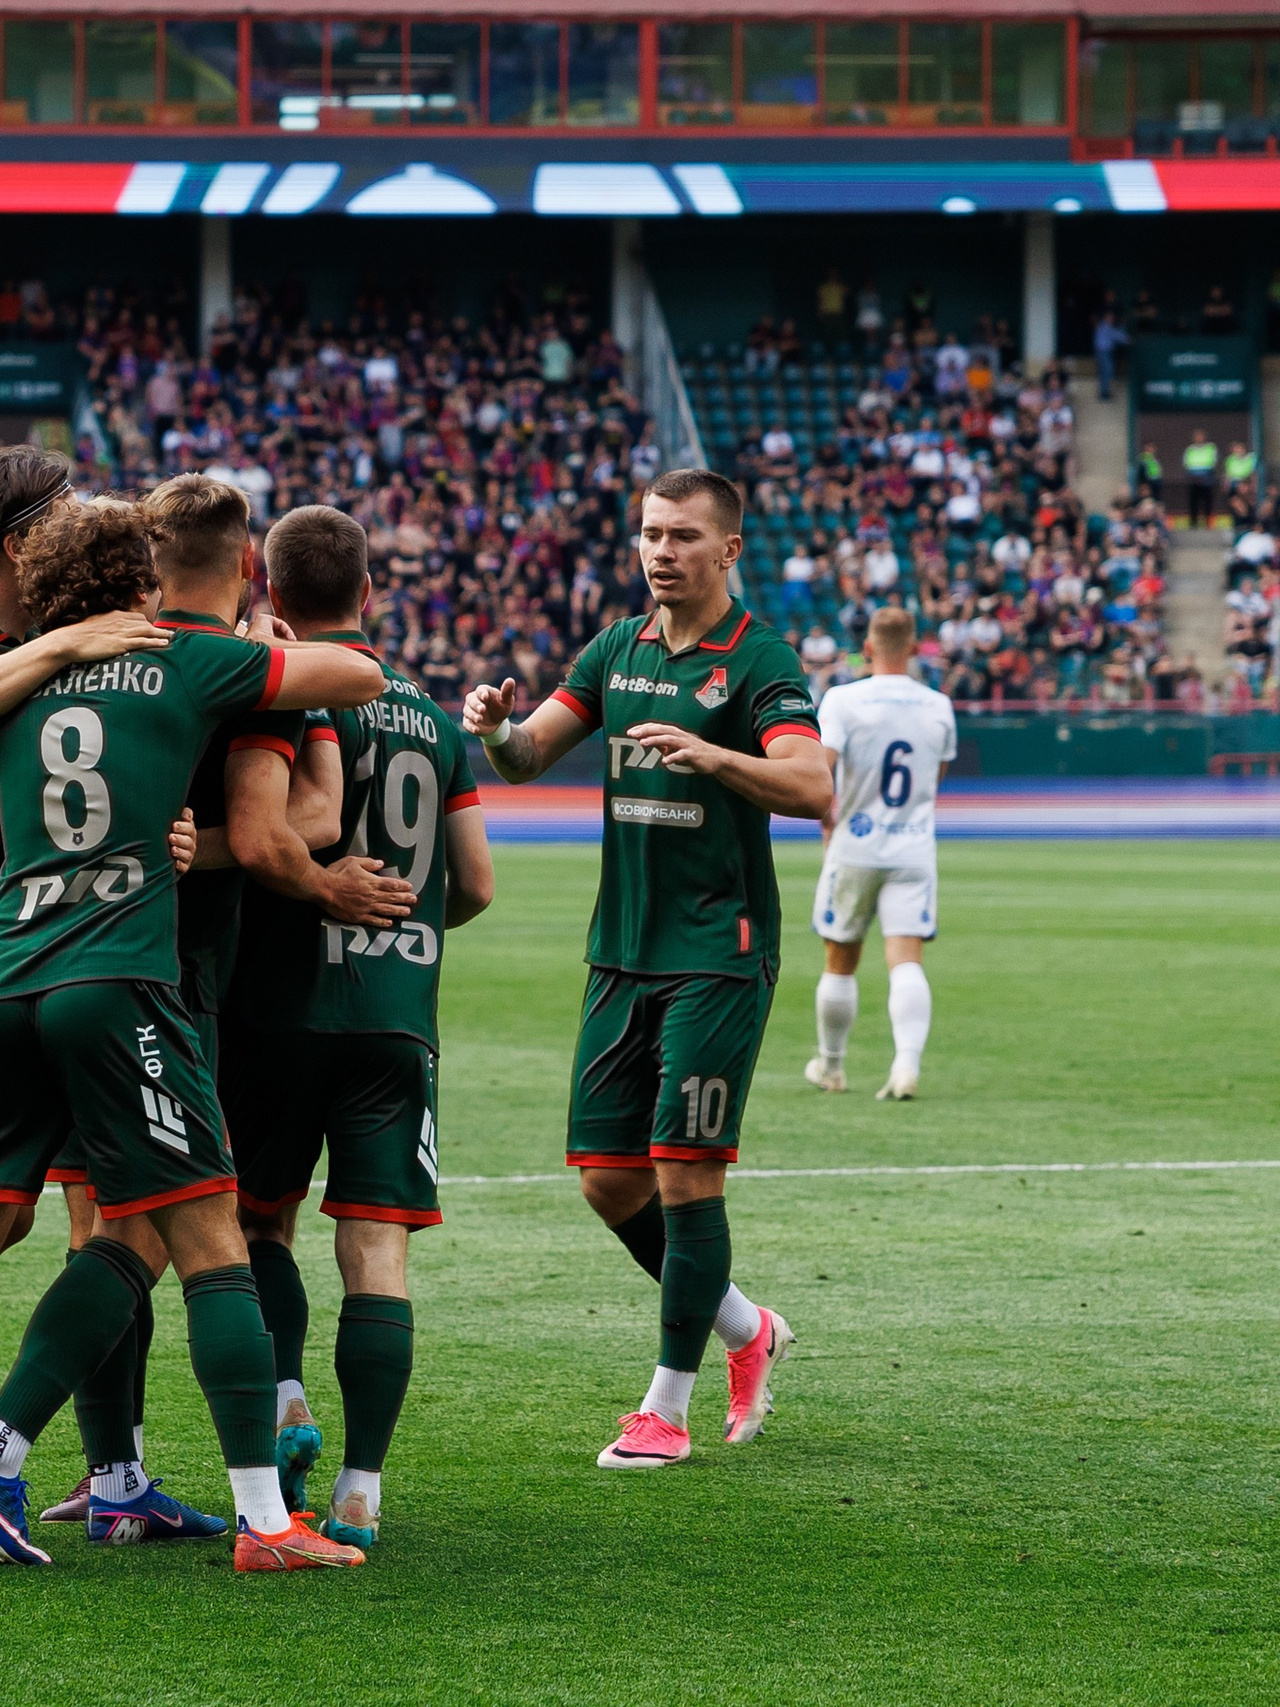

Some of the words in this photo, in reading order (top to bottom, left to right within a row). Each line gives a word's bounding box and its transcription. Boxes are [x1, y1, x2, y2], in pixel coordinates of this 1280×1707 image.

[32, 661, 164, 698] АЛЕНКО
[609, 673, 679, 697] BetBoom
[40, 706, 112, 852] 8
[880, 740, 914, 808] 6
[347, 742, 439, 895] 19
[136, 1024, 164, 1079] ФГК
[681, 1076, 728, 1138] 10
